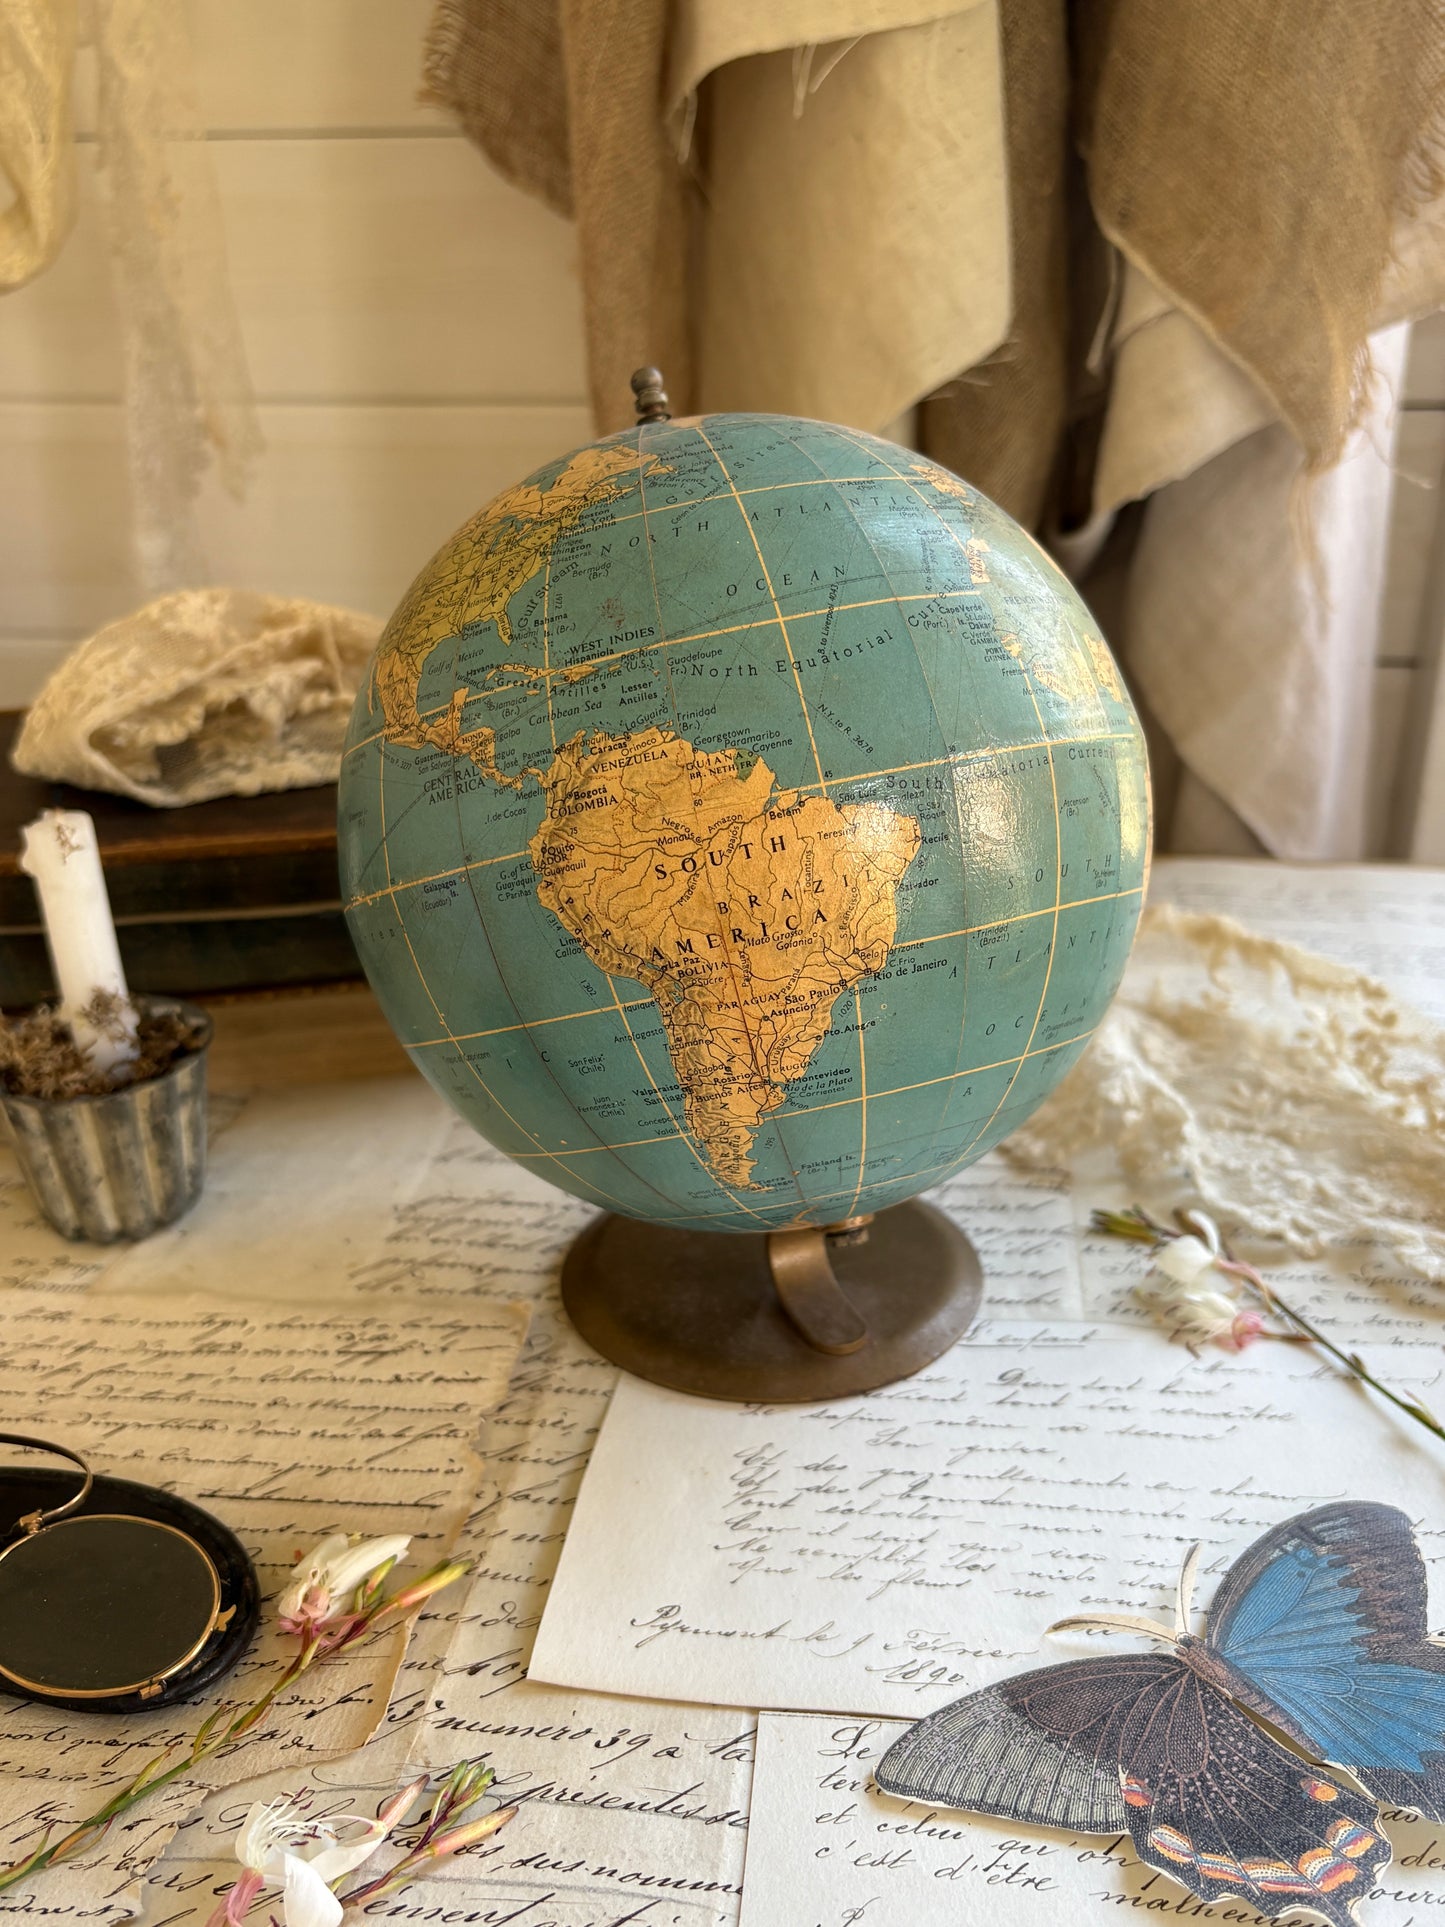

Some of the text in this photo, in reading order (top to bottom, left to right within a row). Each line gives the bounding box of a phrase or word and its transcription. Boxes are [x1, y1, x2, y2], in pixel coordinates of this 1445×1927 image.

[600, 520, 709, 557] NORTH
[750, 495, 916, 522] ATLANTIC
[572, 561, 613, 578] Bermuda
[726, 564, 845, 597] OCEAN
[533, 612, 568, 628] Bahama
[824, 603, 835, 637] Liverpool
[968, 621, 992, 631] Dakar
[569, 626, 656, 656] WEST INDIES
[564, 647, 616, 668] Hispaniola
[666, 648, 724, 668] Guadeloupe
[690, 663, 759, 678] North
[775, 629, 894, 674] Equatorial
[466, 663, 495, 678] Havana
[550, 682, 608, 699] Antilles
[621, 680, 655, 694] Lesser
[618, 690, 659, 708] Antilles
[528, 700, 603, 728] Caribbean Sea
[677, 703, 717, 721] Trinidad
[693, 727, 751, 747] Georgetown
[724, 729, 781, 748] Paramaribo
[752, 737, 793, 754] Cayenne
[852, 735, 874, 754] 3678
[522, 747, 553, 761] Panama
[590, 741, 628, 756] Caracas
[620, 737, 658, 758] Orinoco
[591, 749, 669, 774] VENEZUELA
[686, 751, 744, 771] GUIANA
[423, 765, 481, 793] CENTRAL
[824, 770, 834, 778] 45
[886, 775, 944, 791] South
[428, 779, 487, 806] AMERICA
[573, 785, 608, 801] Bogotá
[550, 794, 619, 820] COLOMBIA
[693, 799, 704, 808] 60
[707, 813, 744, 834] Amazon
[769, 807, 801, 821] Belém
[569, 827, 579, 836] 75
[662, 816, 692, 834] Negro
[547, 843, 576, 857] Quito
[654, 834, 787, 881] SOUTH
[519, 853, 569, 874] ECUADOR
[543, 859, 588, 878] Guayaquil
[803, 849, 813, 895] Tocantins
[1006, 853, 1113, 891] SOUTH
[495, 872, 537, 892] Guayaquil
[676, 872, 700, 907] Madeira
[560, 937, 583, 947] Lima
[649, 908, 828, 963] AMERICA
[555, 947, 583, 960] Callao
[677, 960, 729, 980] BOLIVIA
[874, 957, 949, 982] Rio de Janeiro
[784, 985, 841, 1006] São Paulo
[847, 983, 879, 998] Santos
[623, 1001, 656, 1014] Iquique
[716, 991, 782, 1012] PARAGUAY
[769, 1003, 818, 1018] Asunción
[613, 1027, 665, 1044] Antofagasta
[578, 1063, 607, 1077] (Chile)
[772, 1059, 820, 1075] URUGUAY
[792, 1066, 852, 1086] Montevideo
[712, 1071, 752, 1087] Rosario
[827, 1076, 855, 1089] Plata
[643, 1092, 688, 1107] Santiago
[695, 1083, 764, 1104] Buenos Aires
[598, 1108, 626, 1119] (Chile)
